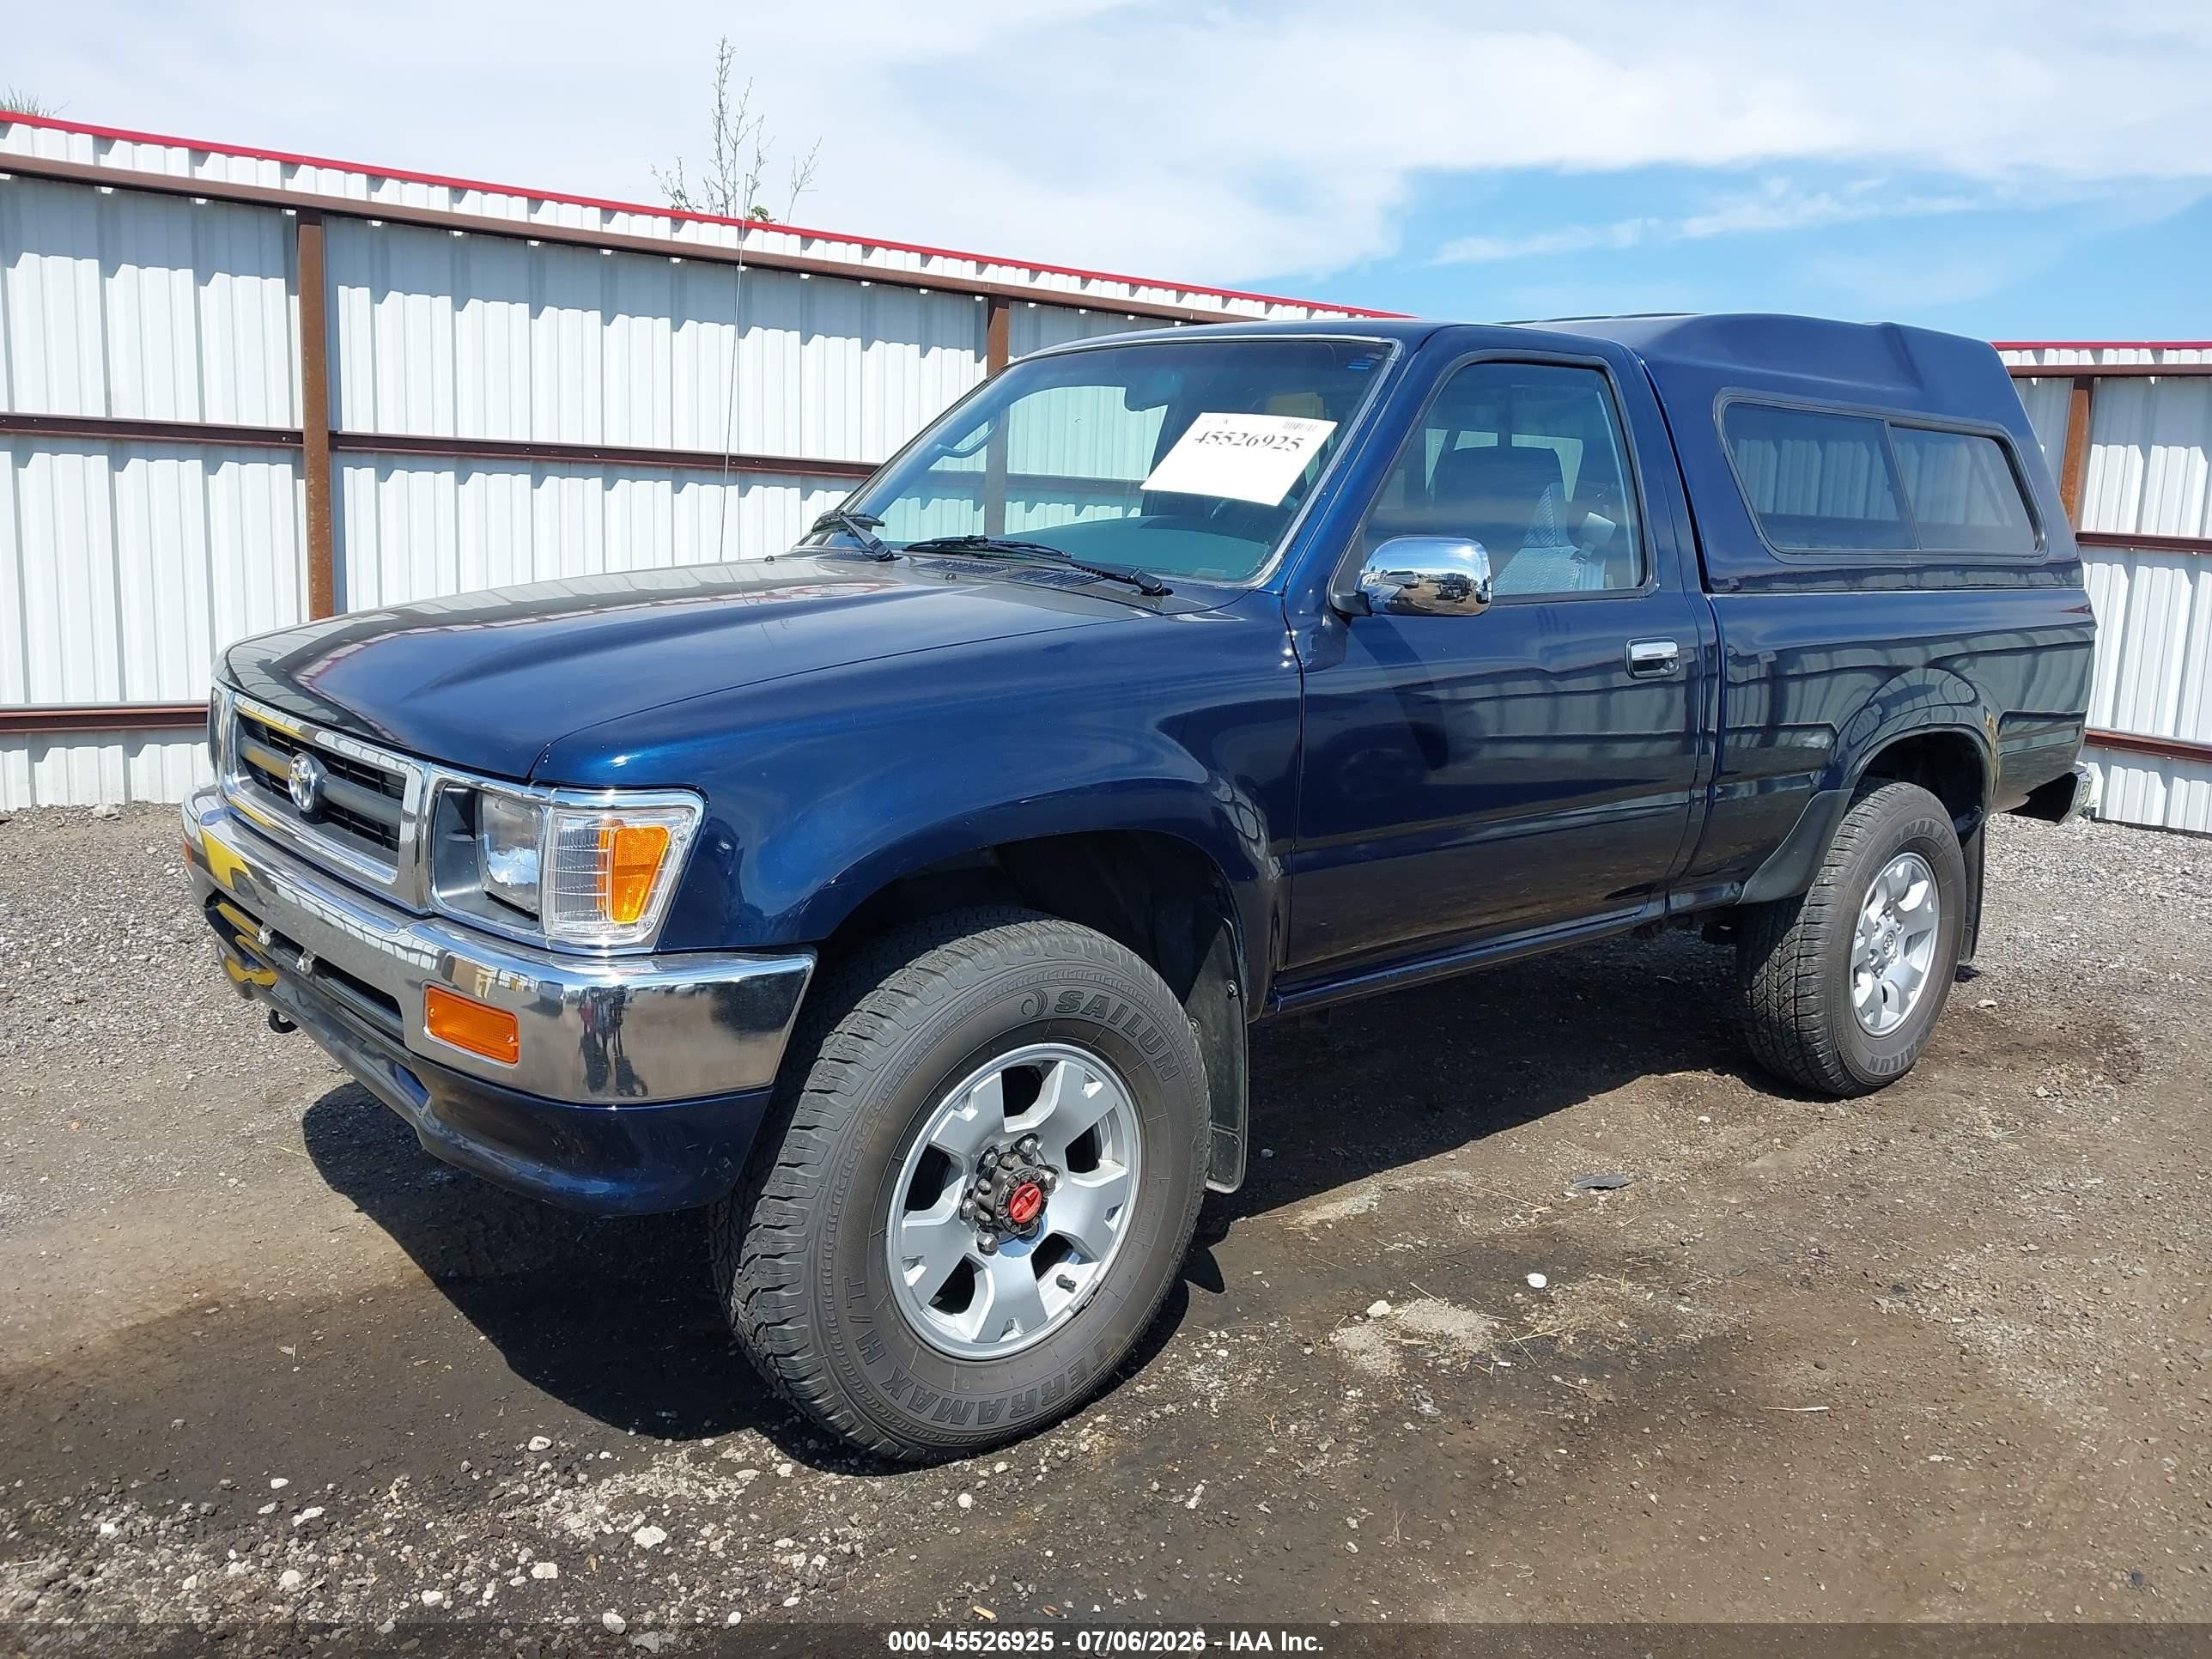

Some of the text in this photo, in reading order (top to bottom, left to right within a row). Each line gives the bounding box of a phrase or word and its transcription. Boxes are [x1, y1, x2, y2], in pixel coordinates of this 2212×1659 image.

[1194, 430, 1304, 452] 45526925
[1054, 991, 1179, 1081] SAILUN
[879, 1337, 1115, 1425] TERRAMAX
